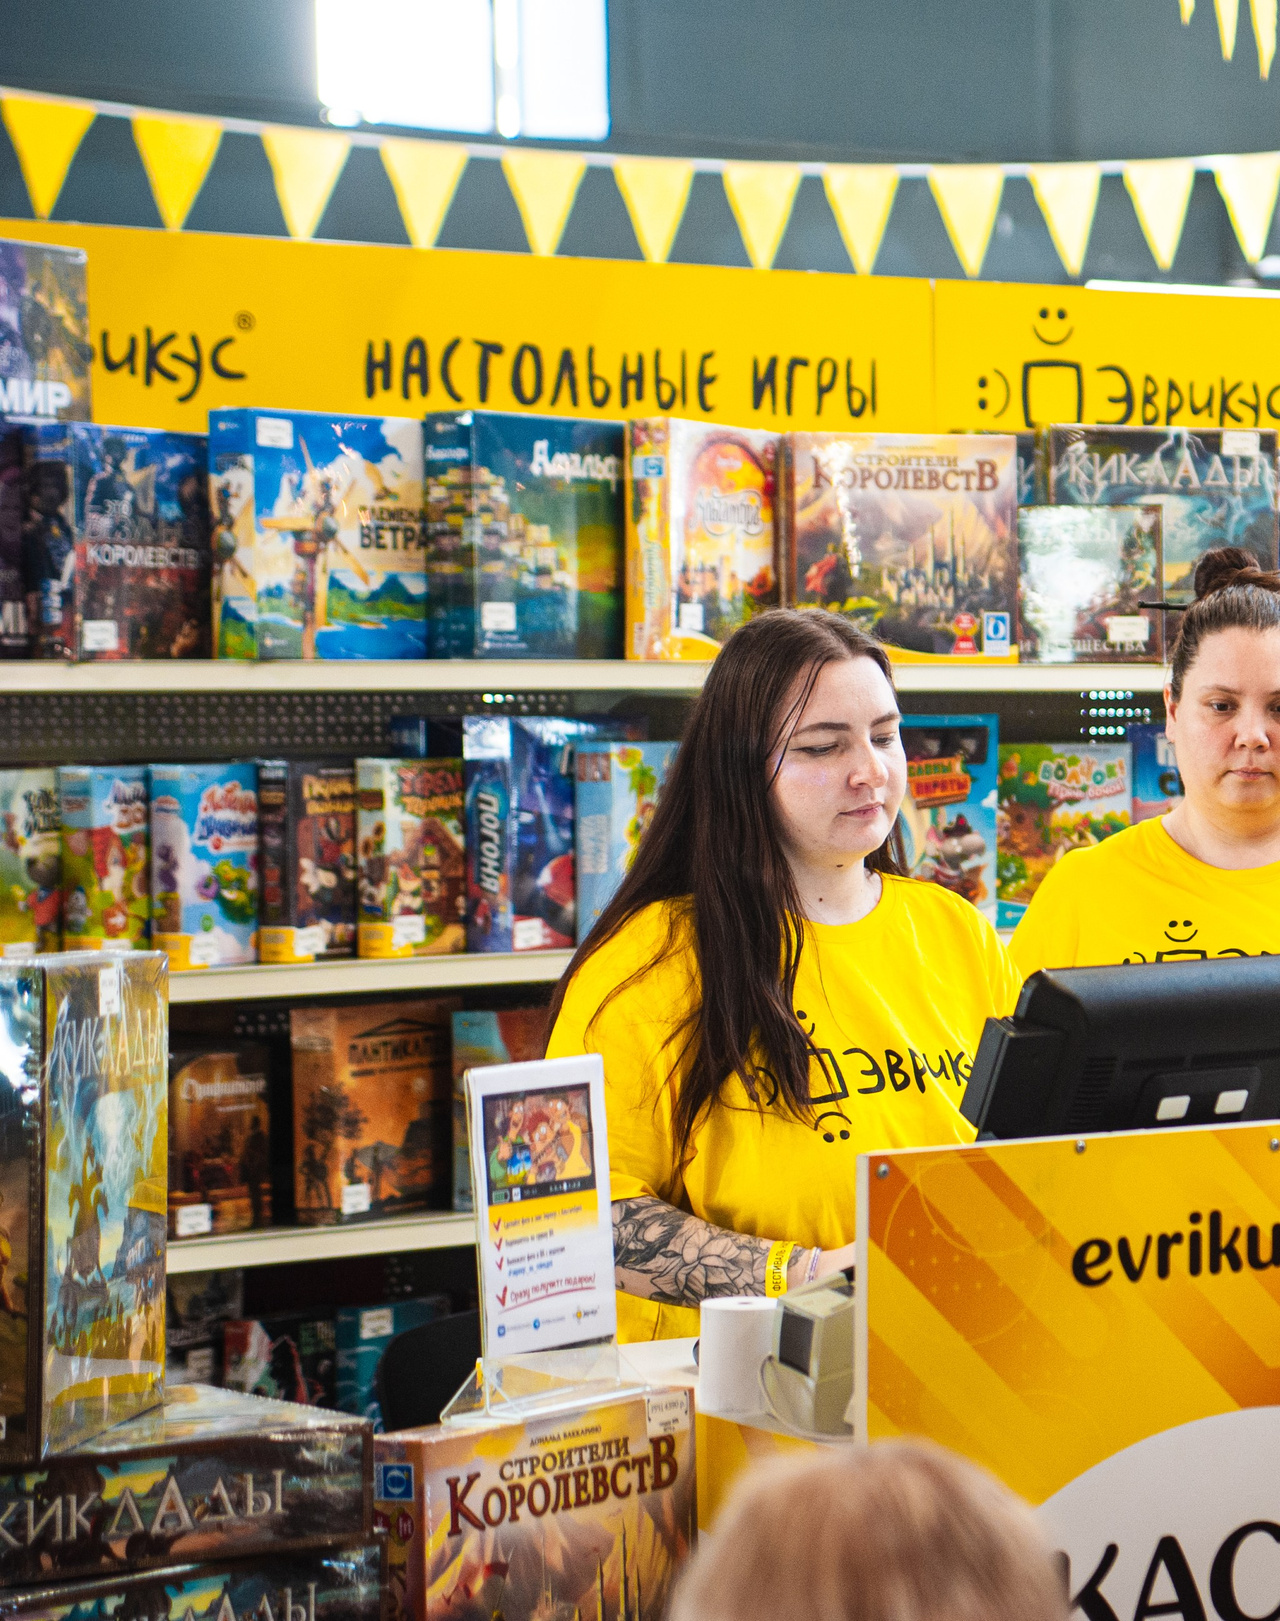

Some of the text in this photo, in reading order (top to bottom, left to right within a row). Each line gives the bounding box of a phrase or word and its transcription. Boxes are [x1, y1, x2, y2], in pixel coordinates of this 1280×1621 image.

[364, 336, 878, 418] НАСТОЛЬНЫЕ ИГРЫ
[853, 453, 960, 467] СТРОИТЕЛИ
[1067, 448, 1264, 490] КИКЛАДЫ
[477, 791, 500, 895] ПОГОНЯ
[499, 1436, 630, 1481] СТРОИТЕЛИ
[529, 1434, 561, 1447] ДОНАЛЬД
[445, 1433, 679, 1538] КОРОЛЕВСТВ
